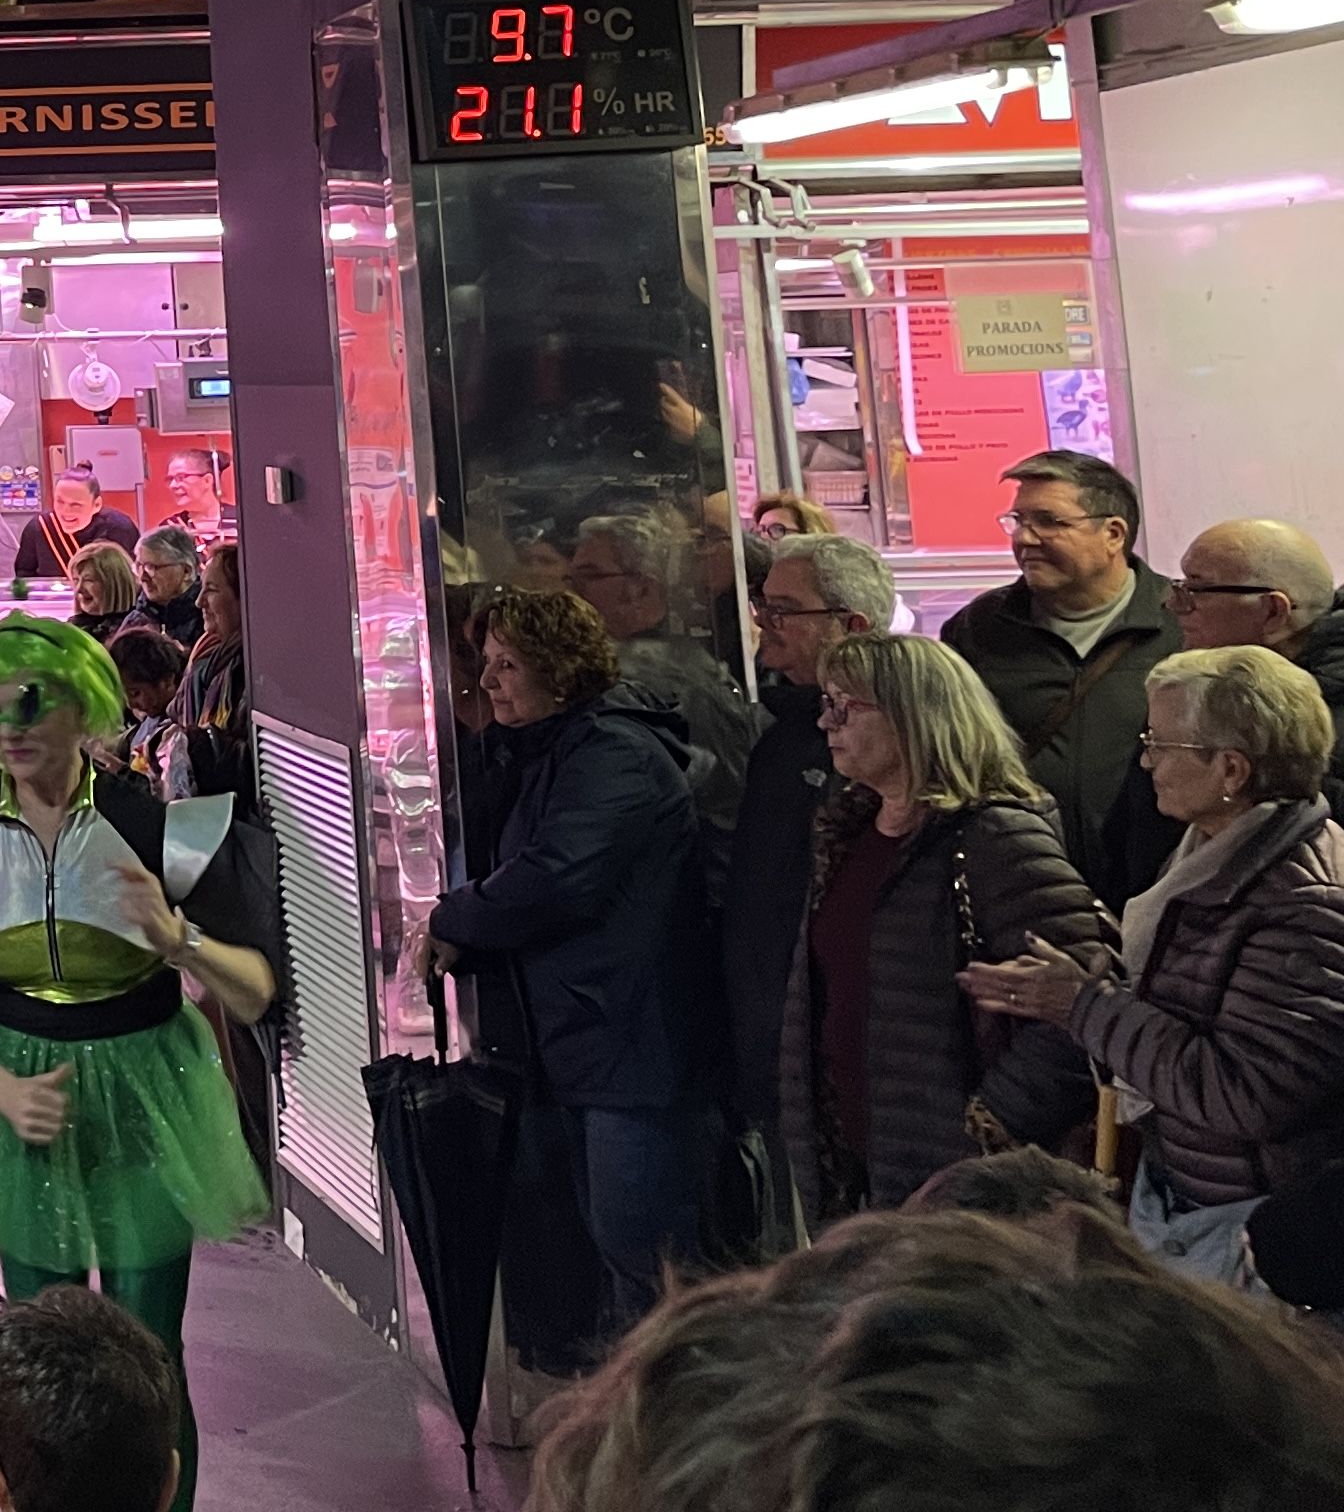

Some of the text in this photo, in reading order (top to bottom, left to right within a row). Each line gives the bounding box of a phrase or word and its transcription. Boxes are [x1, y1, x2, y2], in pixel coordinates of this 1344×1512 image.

[583, 6, 635, 41] °C
[634, 90, 676, 114] HR
[981, 320, 1043, 334] PARADA
[966, 342, 1064, 358] PROMOCIONS
